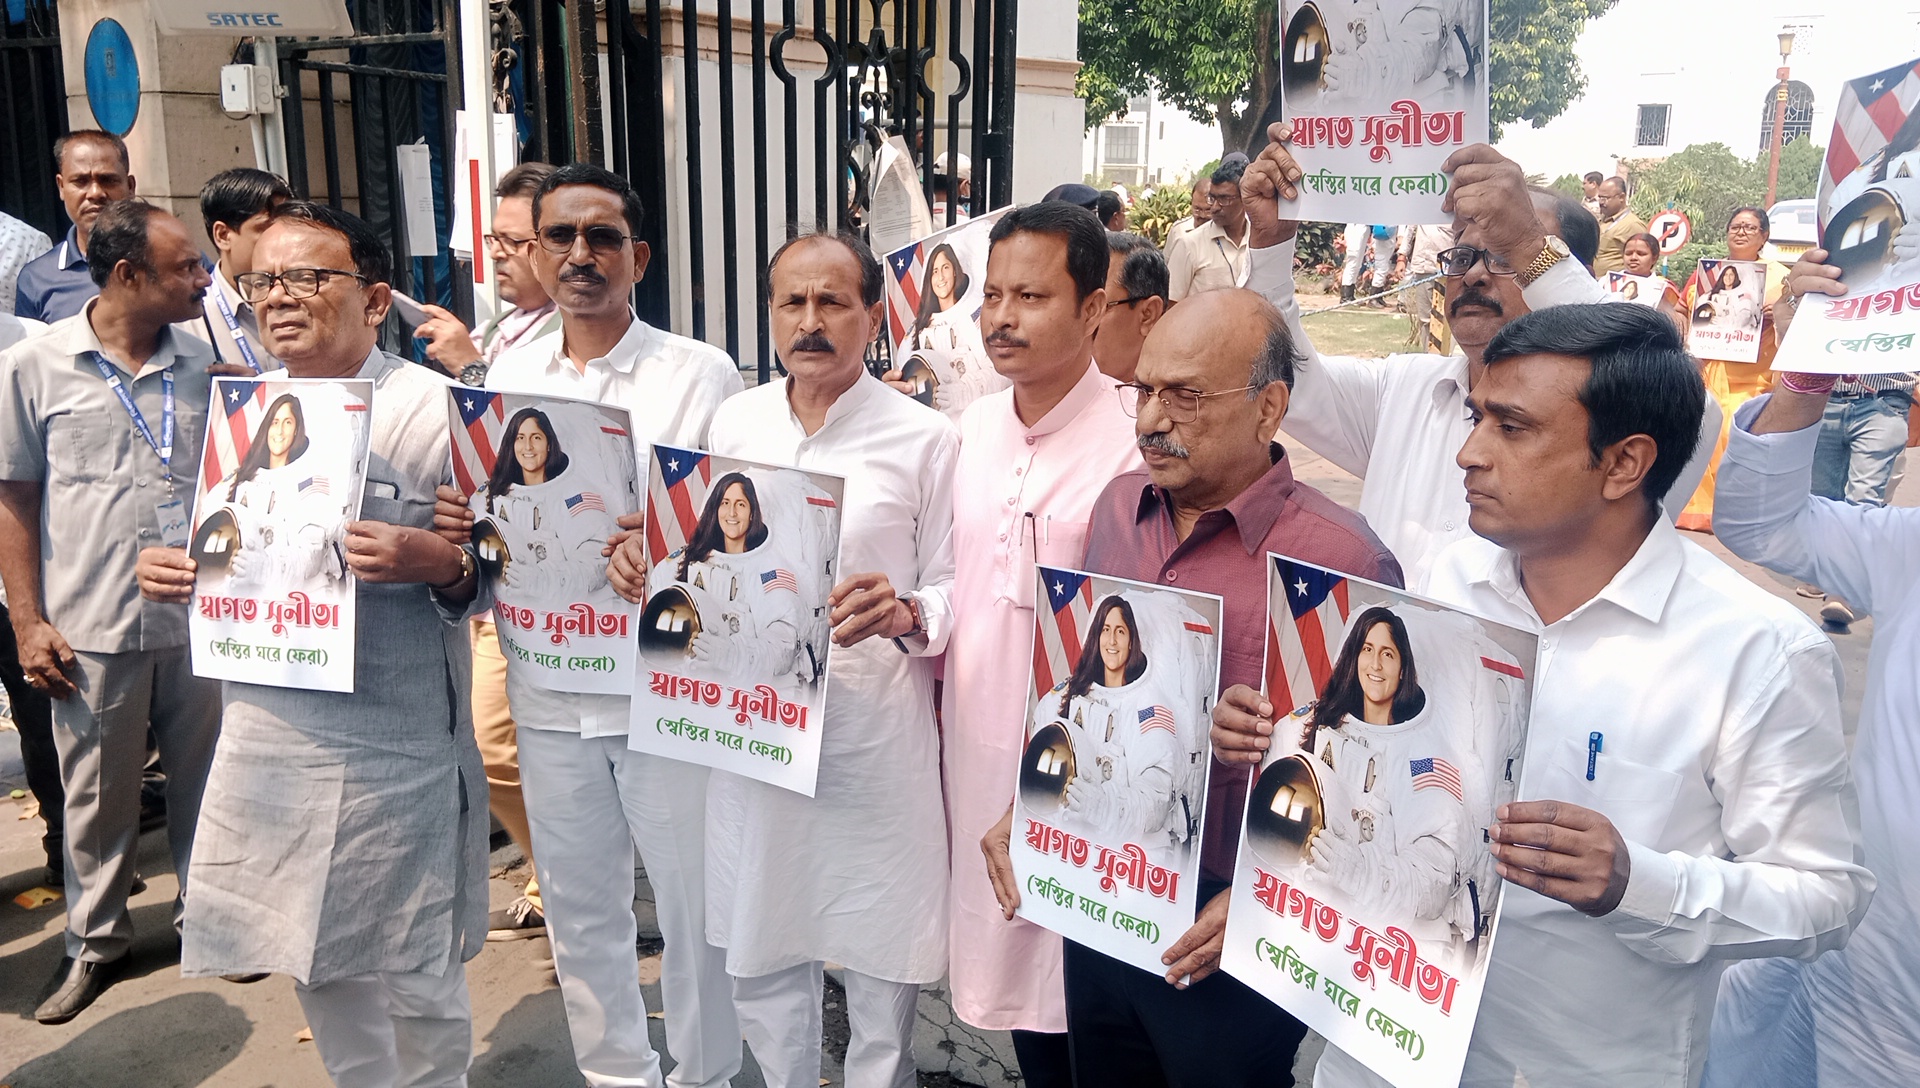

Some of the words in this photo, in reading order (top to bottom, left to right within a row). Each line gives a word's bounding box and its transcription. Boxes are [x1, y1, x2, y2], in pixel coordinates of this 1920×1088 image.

[206, 12, 283, 26] SATEC
[1291, 117, 1355, 148] স্বাগত
[1359, 99, 1466, 163] সুনীতা
[1301, 168, 1346, 196] (স্বস্তির
[1351, 175, 1381, 195] ঘরে
[1389, 172, 1448, 196] ফেরা)
[1825, 333, 1916, 354] (স্বস্তির
[199, 595, 258, 623] স্বাগত
[264, 591, 340, 638] সুনীতা
[541, 602, 629, 647] সুনীতা
[210, 637, 250, 660] (স্বস্তির
[256, 646, 281, 662] ঘরে
[287, 648, 328, 667] ফেরা)
[534, 652, 562, 670] ঘরে
[568, 656, 616, 673] ফেরা)
[648, 670, 723, 707] স্বাগত
[727, 684, 810, 732] সুনীতা
[656, 717, 709, 742] (স্বস্তির
[715, 730, 743, 750] ঘরে
[749, 740, 793, 765] ফেরা)
[1025, 818, 1091, 868] স্বাগত
[1093, 842, 1180, 903] সুনীতা
[1028, 875, 1074, 908] (স্বস্তির
[1079, 896, 1107, 923] ঘরে
[1113, 910, 1160, 944] ফেরা)
[1252, 866, 1343, 942] স্বাগত
[1345, 918, 1460, 1017] সুনীতা
[1256, 937, 1318, 991] (স্বস্তির
[1324, 977, 1361, 1018] ঘরে
[1366, 1007, 1424, 1061] ফেরা)
